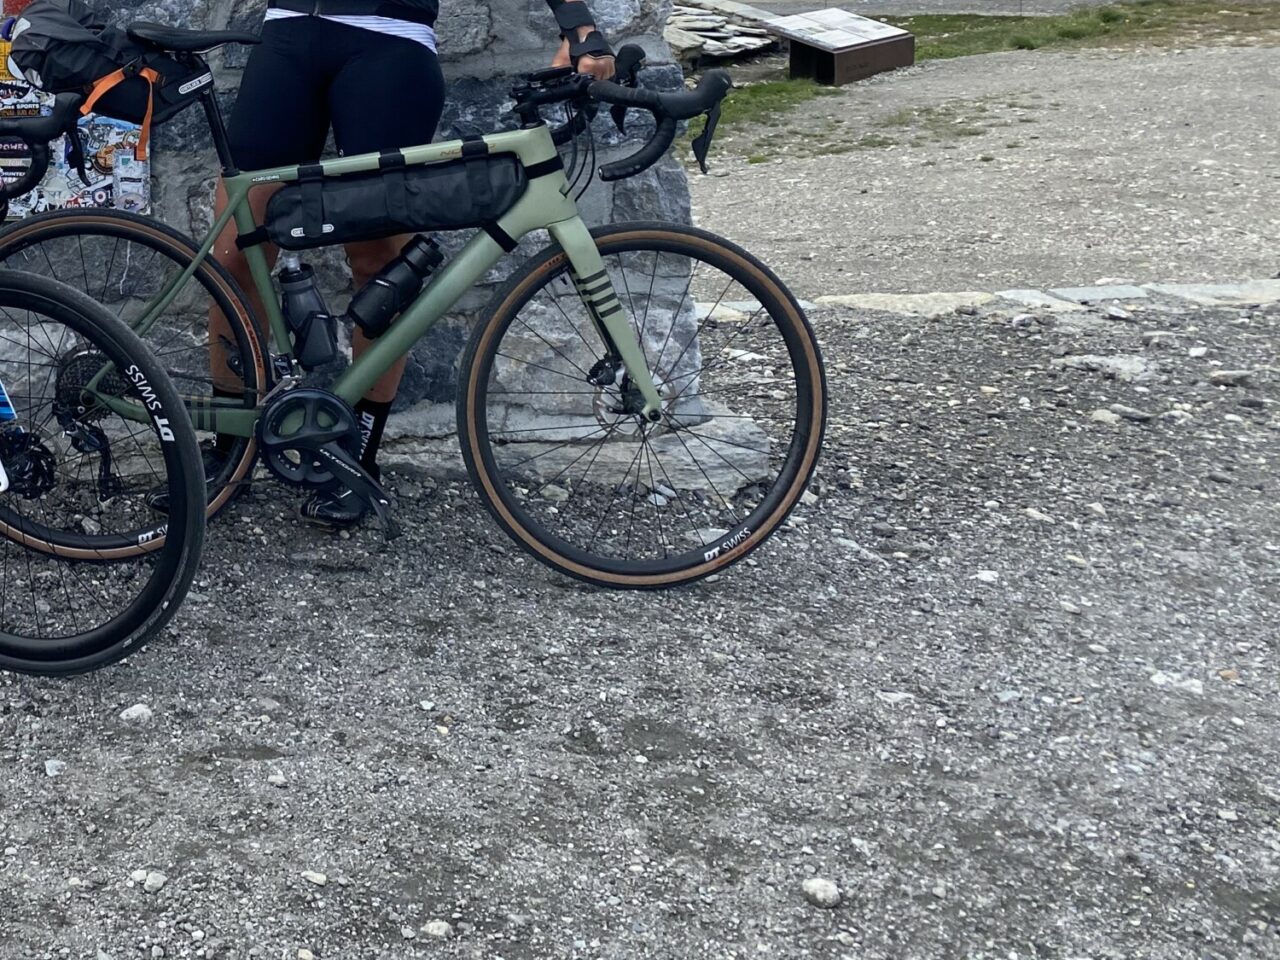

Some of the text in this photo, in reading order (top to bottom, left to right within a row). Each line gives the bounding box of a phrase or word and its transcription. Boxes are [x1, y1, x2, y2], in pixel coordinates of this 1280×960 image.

[125, 365, 176, 442] DT SWISS
[722, 527, 752, 552] SWISS
